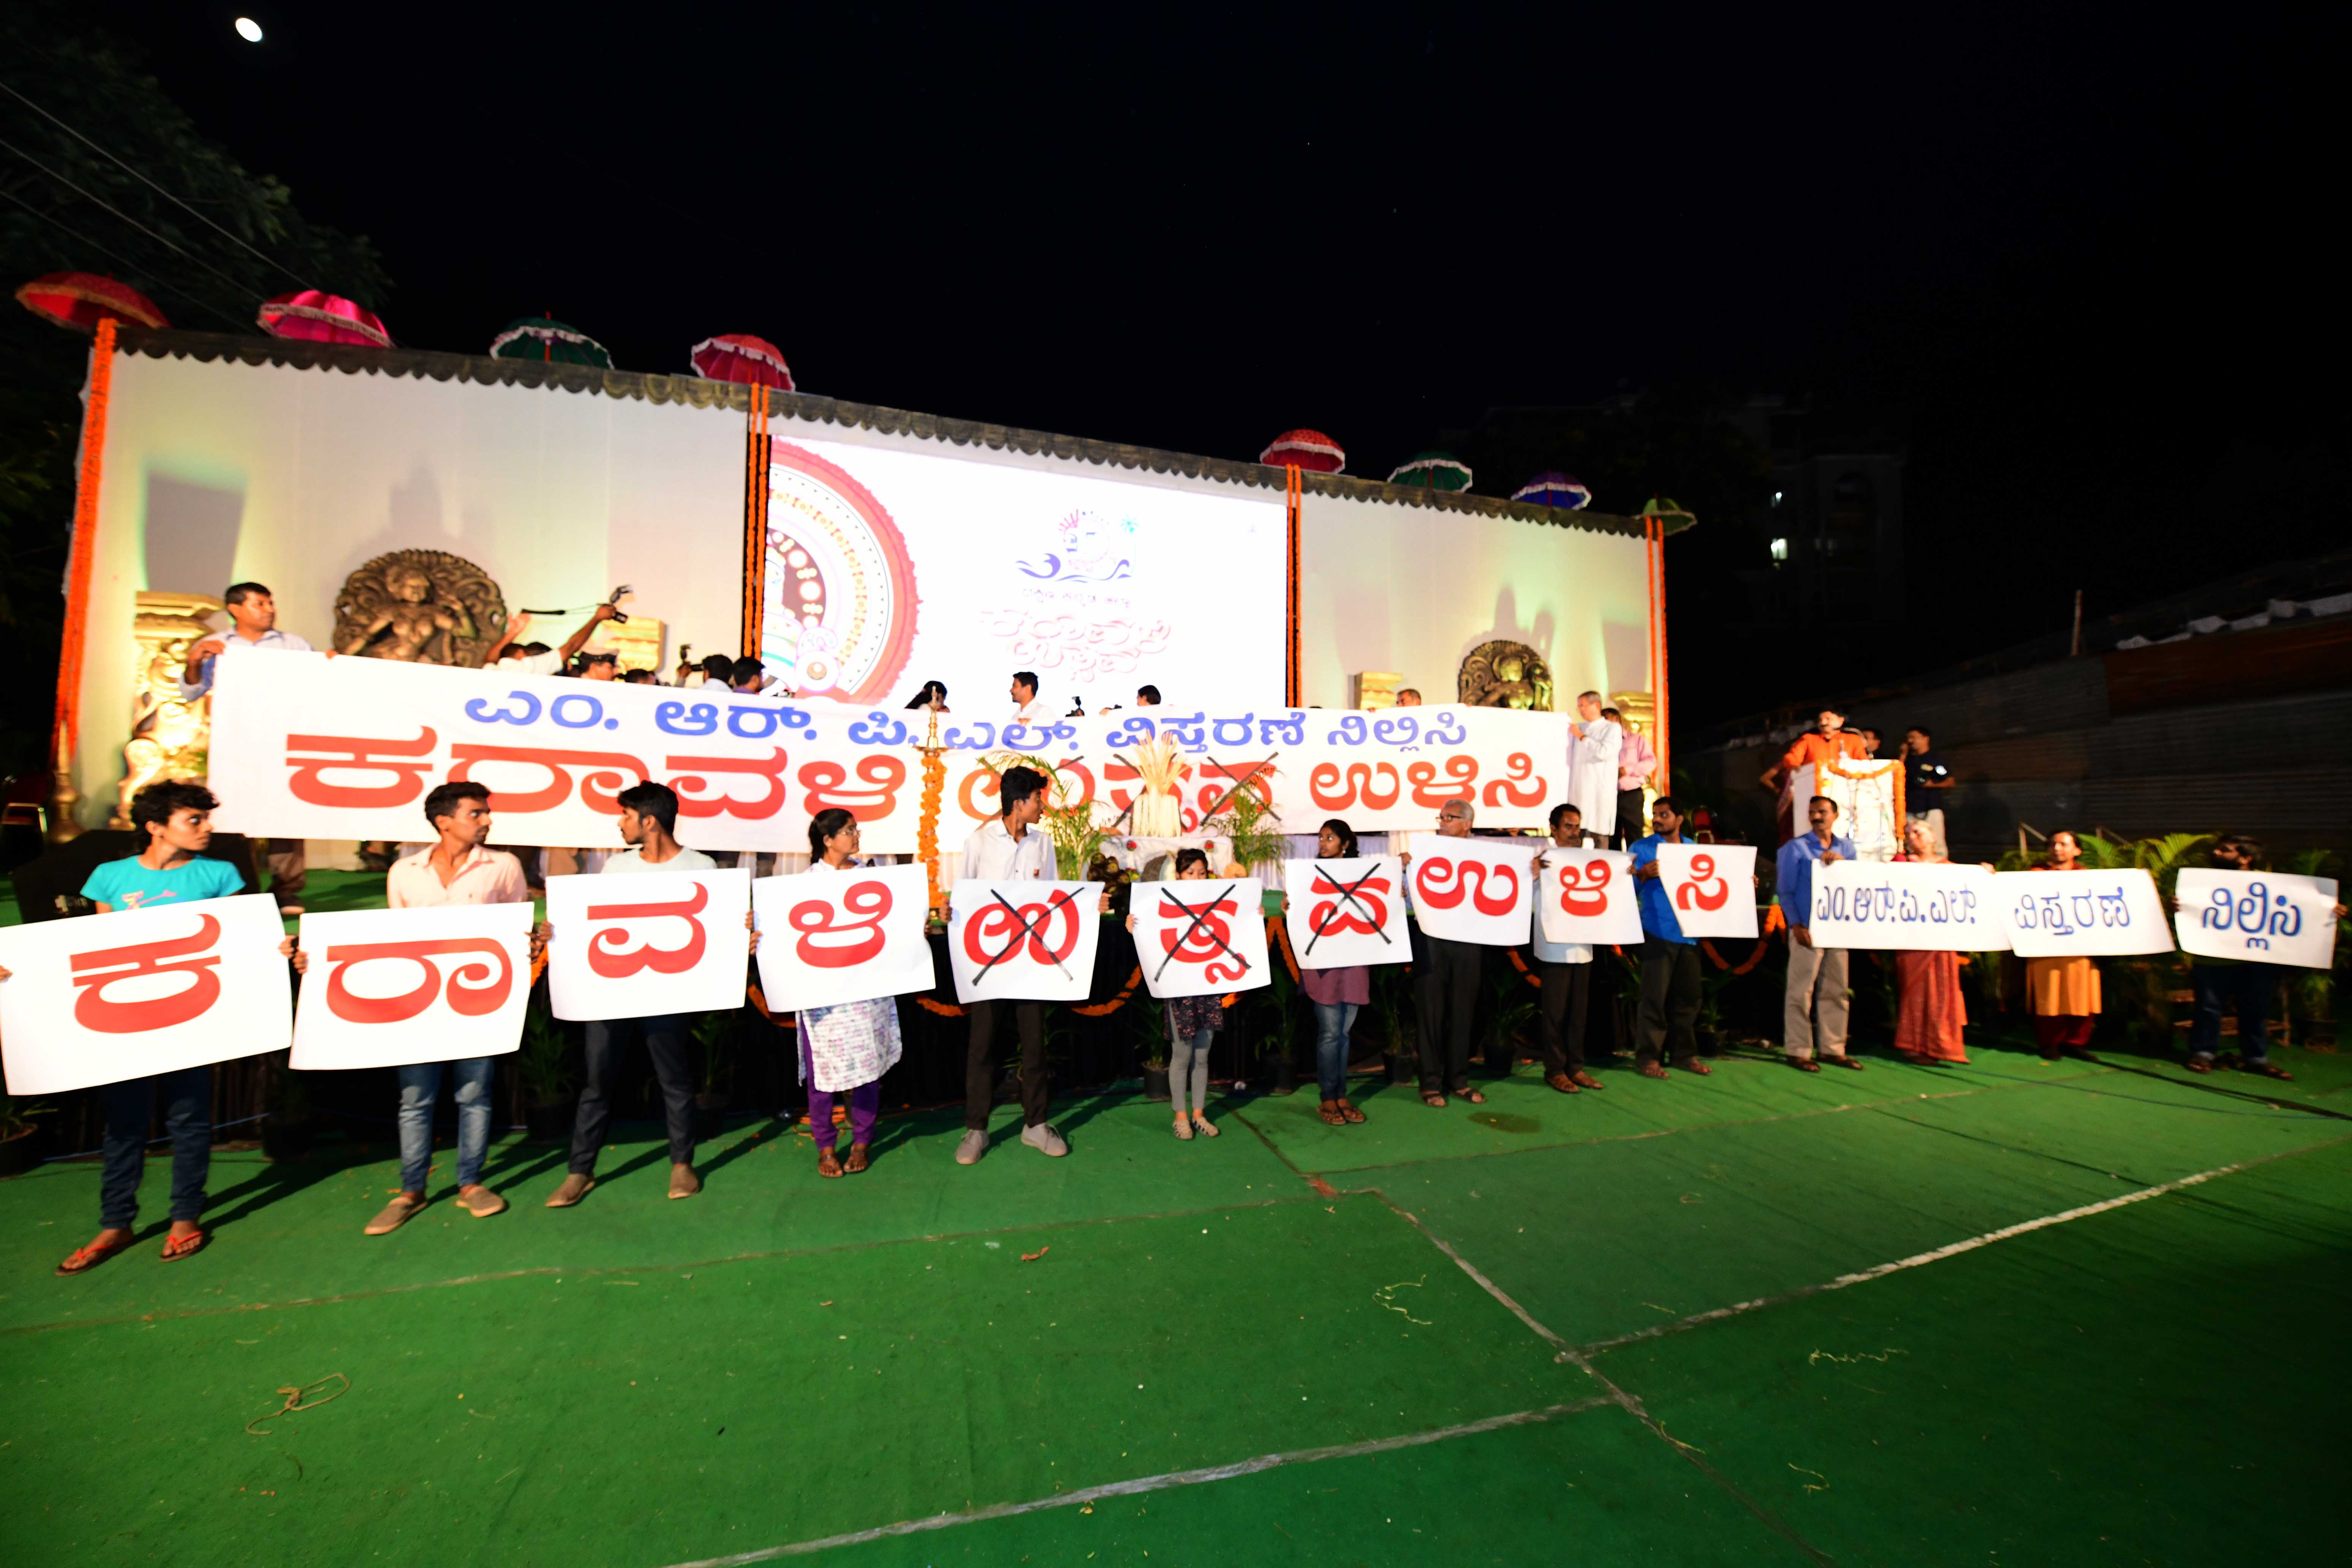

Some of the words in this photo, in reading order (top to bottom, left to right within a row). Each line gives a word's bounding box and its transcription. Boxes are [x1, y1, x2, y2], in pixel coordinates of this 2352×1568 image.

[465, 691, 618, 730] ಎಂ.
[655, 701, 817, 740] ಆರ್.
[848, 711, 919, 745] ಪಿ.
[945, 721, 1078, 750] ಎಲ್.
[1106, 711, 1306, 753] ವಿಸ್ತರಣೆ
[1328, 712, 1467, 752] ನಿಲ್ಲಿಸಿ
[286, 725, 906, 822] ಕರಾವಳಿ
[1310, 752, 1547, 811] ಉಳಿಸಿ
[1416, 857, 1519, 917] ಉ
[1559, 858, 1612, 917] ಳಿ
[1676, 854, 1729, 911] ಸಿ
[2014, 887, 2130, 935] ವಿಸ್ತರಣೆ
[2202, 882, 2302, 950] ನಿಲ್ಲಿಸಿ
[587, 882, 708, 978] ವ
[789, 880, 893, 968] ಳಿ
[963, 889, 1080, 967] ಉ
[70, 914, 221, 1033] ಕ
[327, 937, 512, 1024] ರಾ
